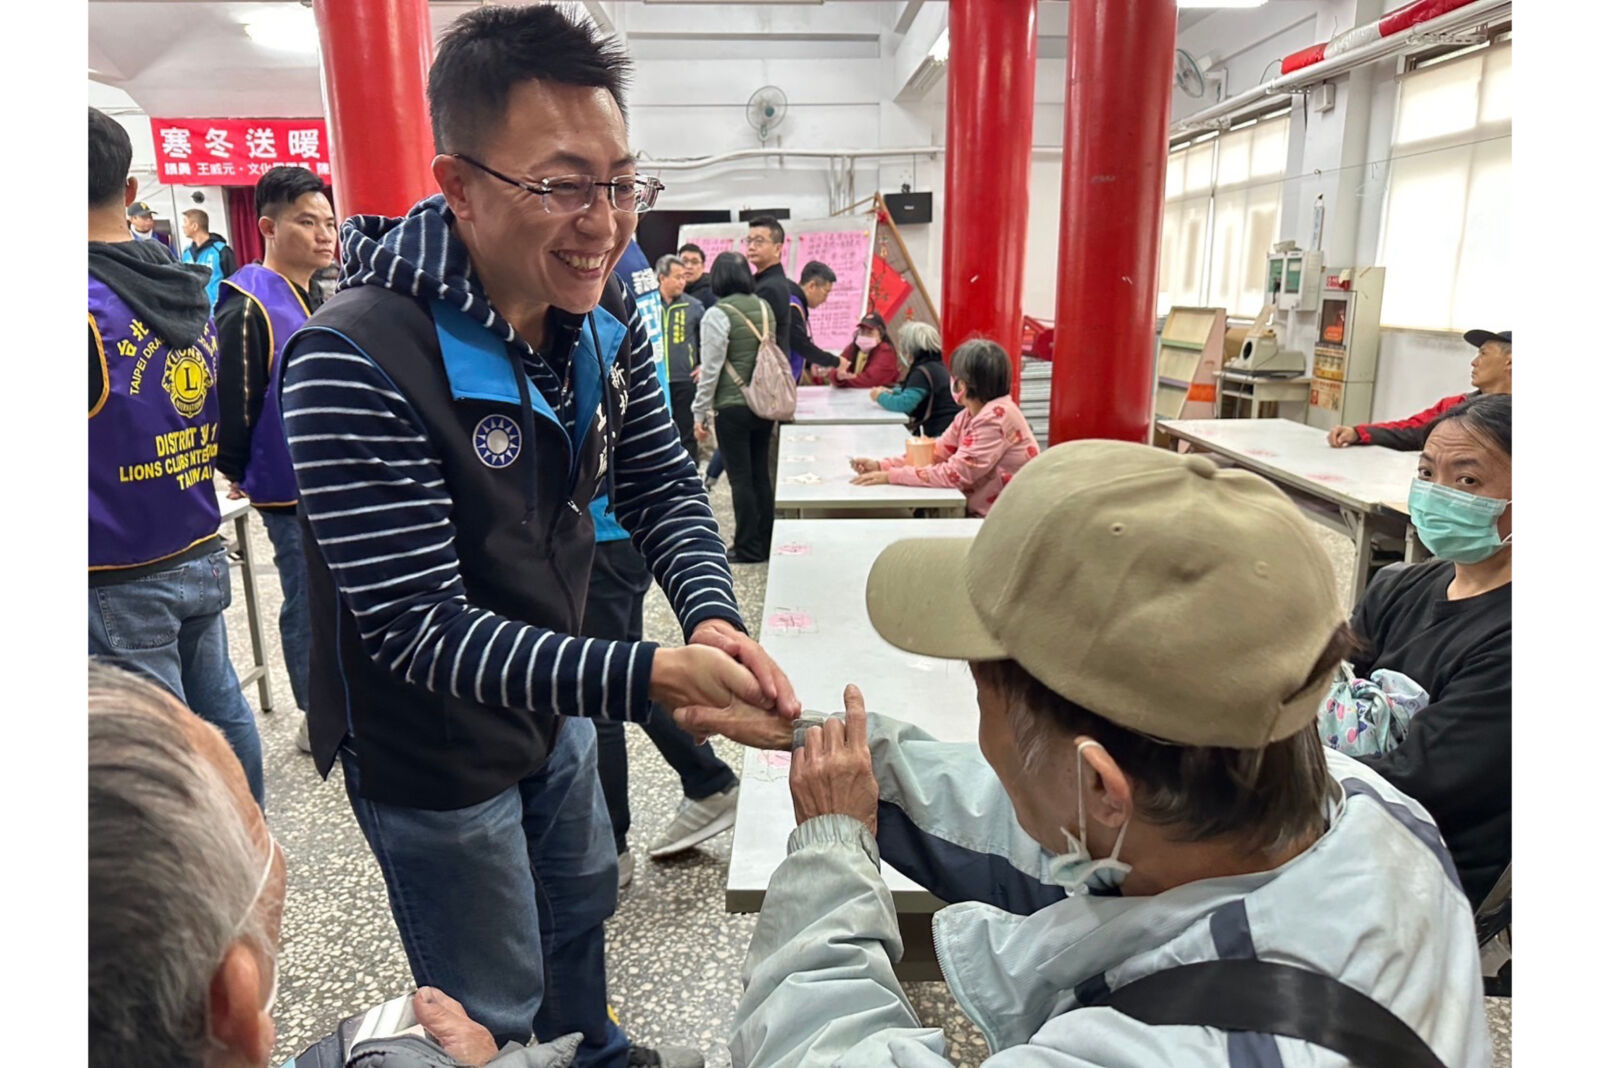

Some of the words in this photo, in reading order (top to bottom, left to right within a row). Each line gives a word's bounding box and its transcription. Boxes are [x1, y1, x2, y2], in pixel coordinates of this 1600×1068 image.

[160, 127, 321, 159] 寒冬送暖
[130, 356, 147, 396] TAIPEI
[184, 367, 198, 391] L
[119, 461, 163, 482] LIONS
